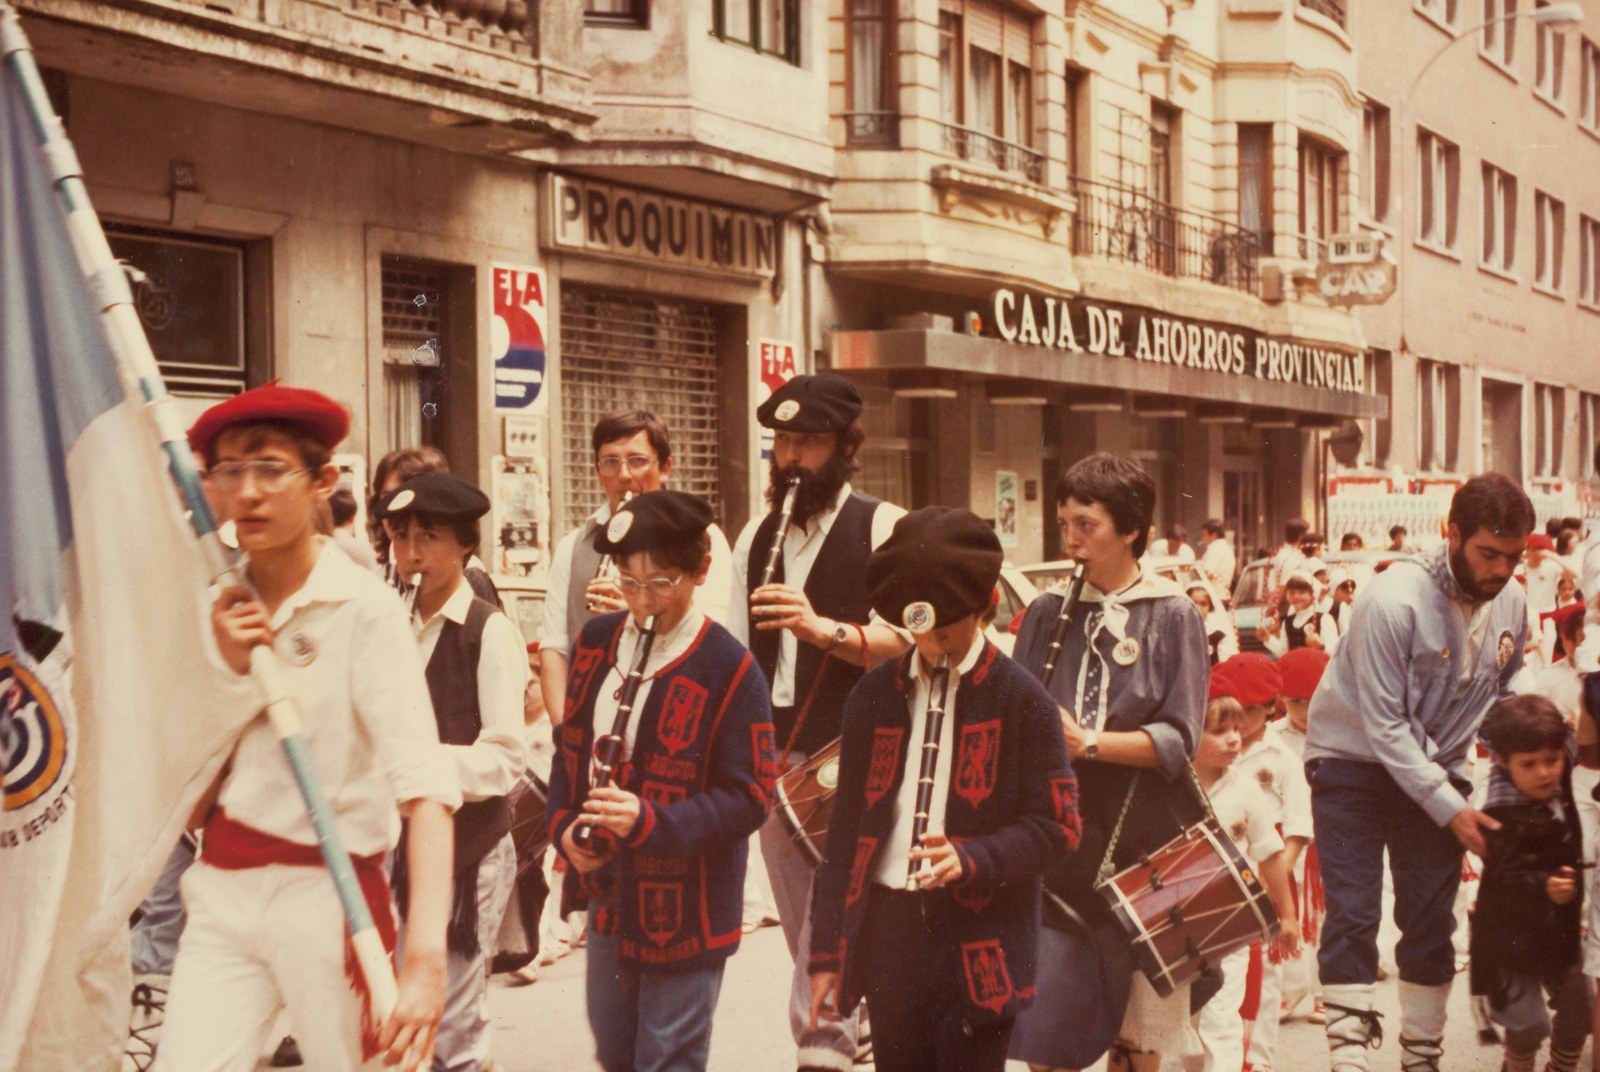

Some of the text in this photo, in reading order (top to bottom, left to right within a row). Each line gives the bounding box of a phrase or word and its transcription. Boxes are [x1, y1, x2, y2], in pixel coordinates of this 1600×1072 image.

[560, 185, 774, 273] PROQUIMIN
[493, 267, 544, 307] ELA
[1321, 271, 1386, 297] CAP
[761, 342, 796, 376] ELA
[994, 289, 1365, 393] CAJA DE AHORROS PROVINCIAL
